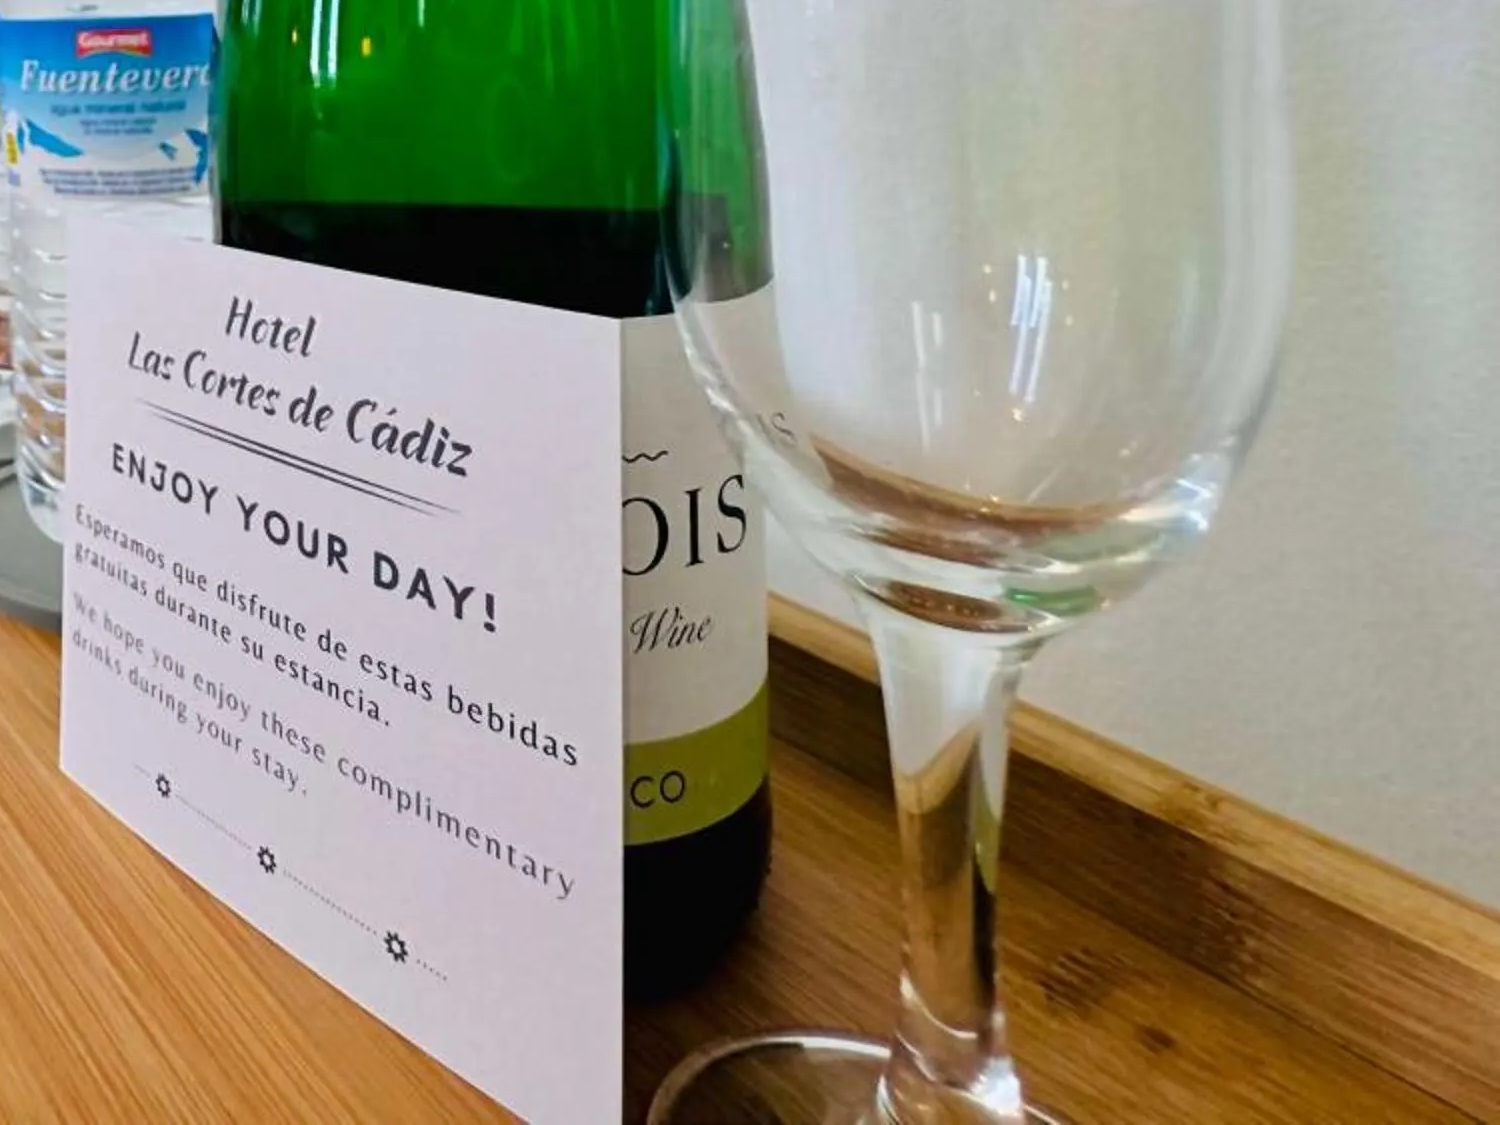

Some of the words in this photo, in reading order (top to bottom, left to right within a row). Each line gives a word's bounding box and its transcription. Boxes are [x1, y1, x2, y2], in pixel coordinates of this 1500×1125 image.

[128, 331, 176, 380] Las
[183, 349, 281, 416] Cortes
[288, 385, 334, 432] de
[346, 398, 473, 477] Cádiz
[225, 295, 317, 357] Hotel
[113, 443, 218, 515] ENJOY
[236, 494, 349, 575] YOUR
[373, 550, 496, 633] DAY!
[71, 628, 121, 675] drinks
[128, 666, 187, 724] during
[196, 712, 242, 753] your
[251, 746, 308, 796] stay.
[74, 542, 148, 597] gratuitas
[154, 586, 232, 644] durante
[241, 634, 264, 661] su
[274, 652, 390, 727] estancia.
[75, 503, 166, 570] Esperamos
[172, 561, 207, 593] que
[216, 580, 307, 642] disfrute
[317, 628, 348, 660] de
[359, 653, 434, 702] estas
[447, 684, 578, 767] bebidas
[629, 606, 714, 654] Wine
[73, 592, 98, 621] We
[103, 613, 145, 655] hope
[152, 648, 186, 680] you
[192, 672, 251, 723] enjoy
[261, 710, 326, 764] these
[337, 756, 575, 900] complimentary
[629, 769, 686, 809] CO
